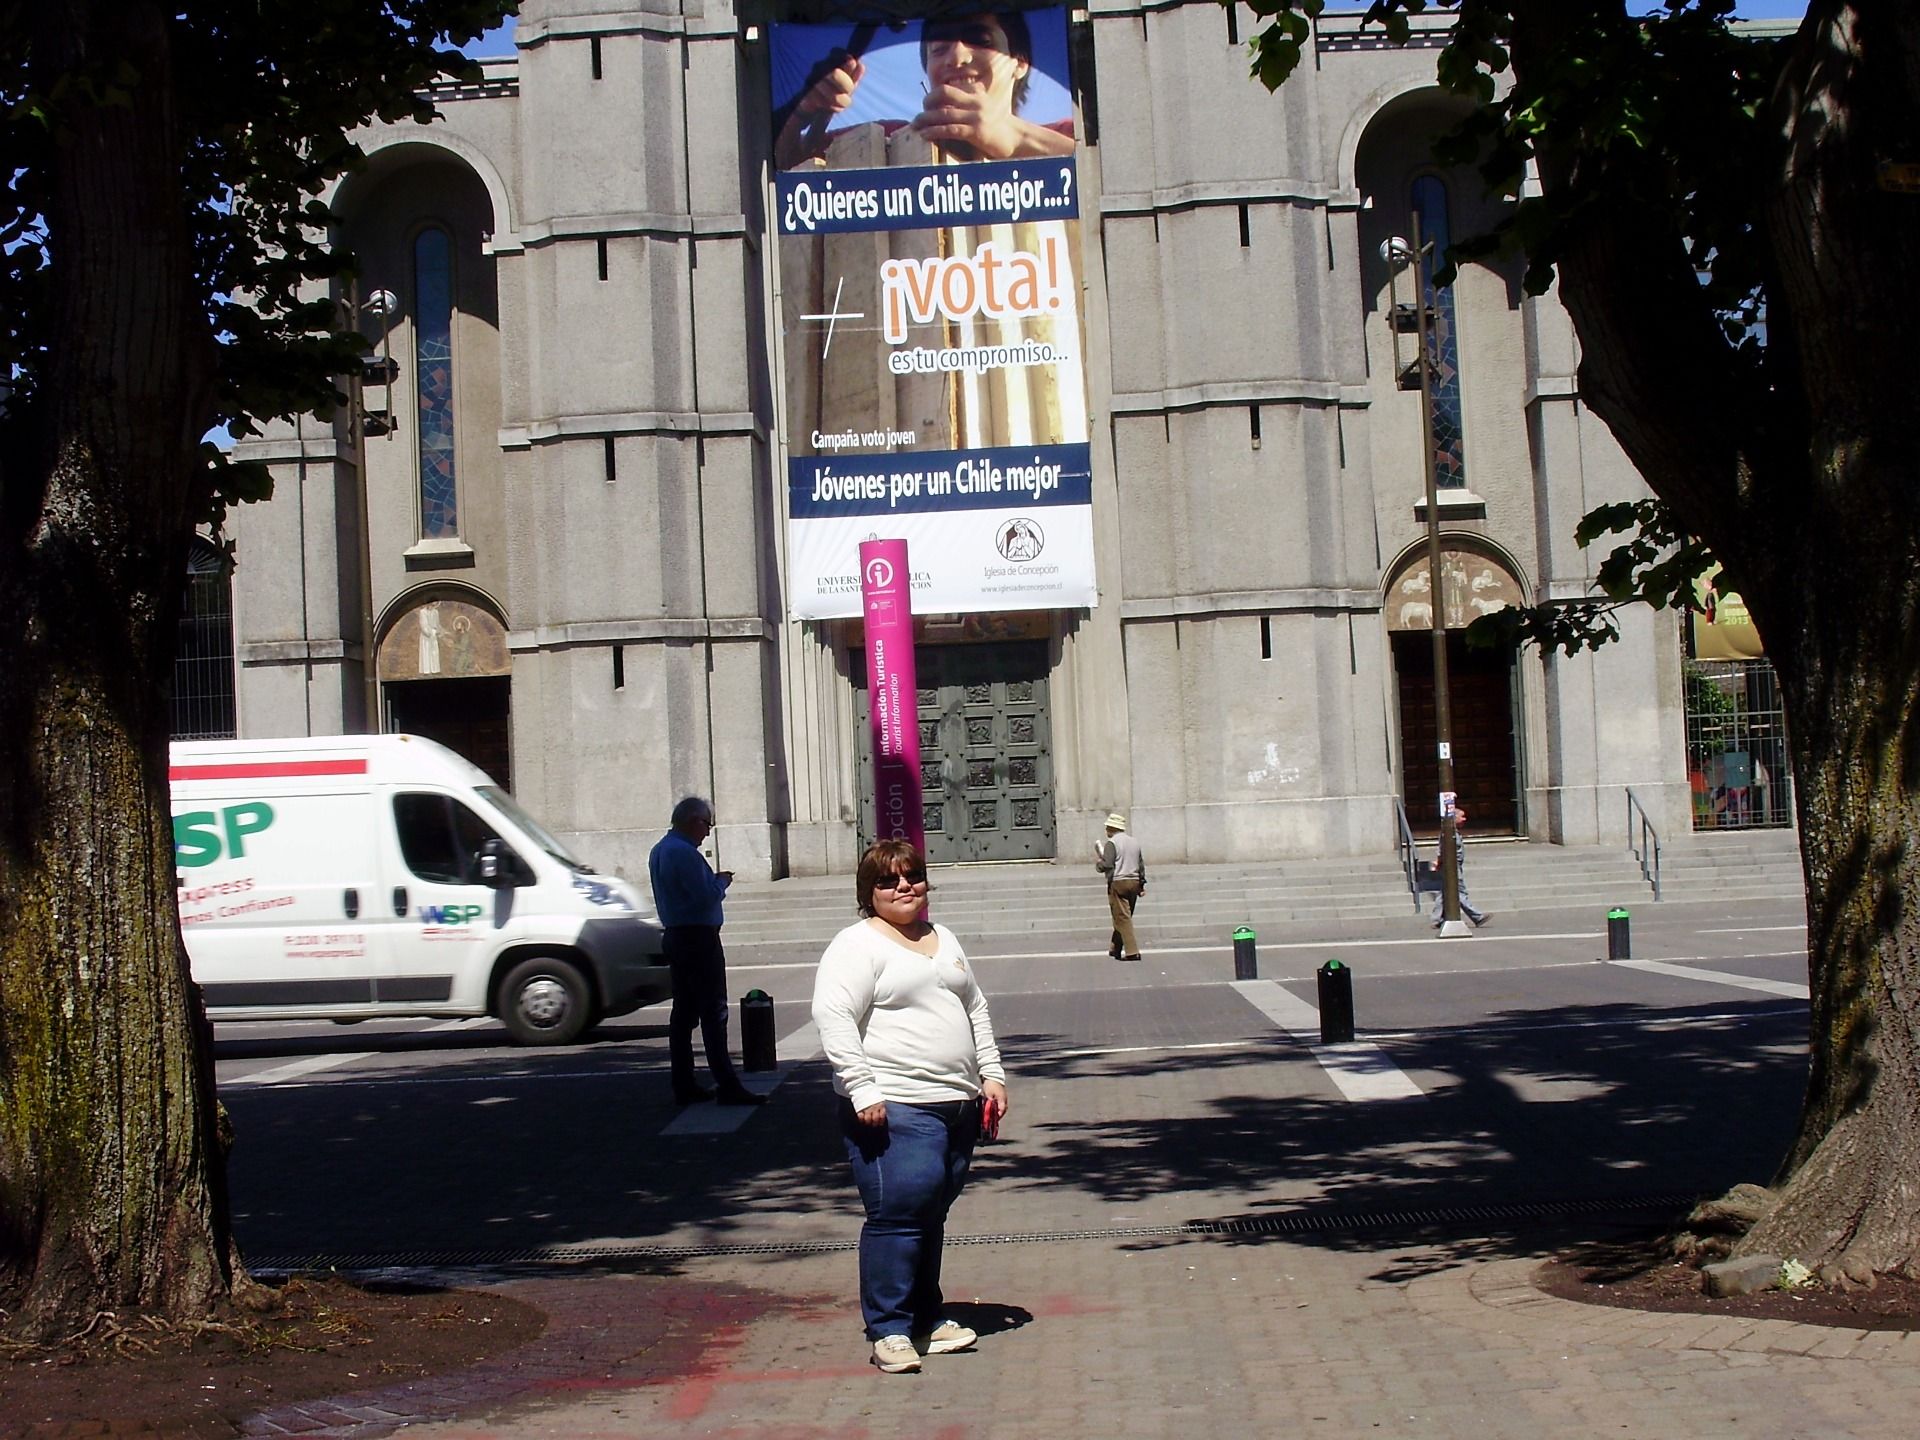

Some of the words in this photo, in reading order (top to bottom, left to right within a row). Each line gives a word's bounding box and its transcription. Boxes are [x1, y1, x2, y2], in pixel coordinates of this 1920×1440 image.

[784, 180, 879, 231] ¿Quieres
[883, 187, 913, 217] un
[918, 173, 973, 215] Chile
[978, 167, 1073, 221] mejor...?
[887, 236, 1061, 338] ¡vota!
[941, 341, 1069, 371] compromiso...
[811, 427, 860, 452] Campaña
[861, 430, 885, 447] voto
[886, 427, 916, 450] joven
[811, 467, 886, 502] Jóvenes
[890, 472, 921, 507] por
[927, 471, 951, 496] un
[955, 458, 1001, 494] Chile
[1006, 456, 1061, 500] mejor
[817, 575, 862, 587] UNIVERSI
[908, 572, 932, 582] LICA
[984, 566, 1006, 580] Iglesia
[1007, 566, 1017, 576] de
[817, 587, 827, 595] DE
[840, 584, 863, 593] SANT
[889, 673, 901, 724] Information
[878, 688, 890, 756] Información
[892, 725, 903, 755] Tourist
[886, 784, 910, 842] pción
[171, 801, 274, 868] SP
[178, 878, 255, 906] xpress
[179, 911, 214, 925] mos
